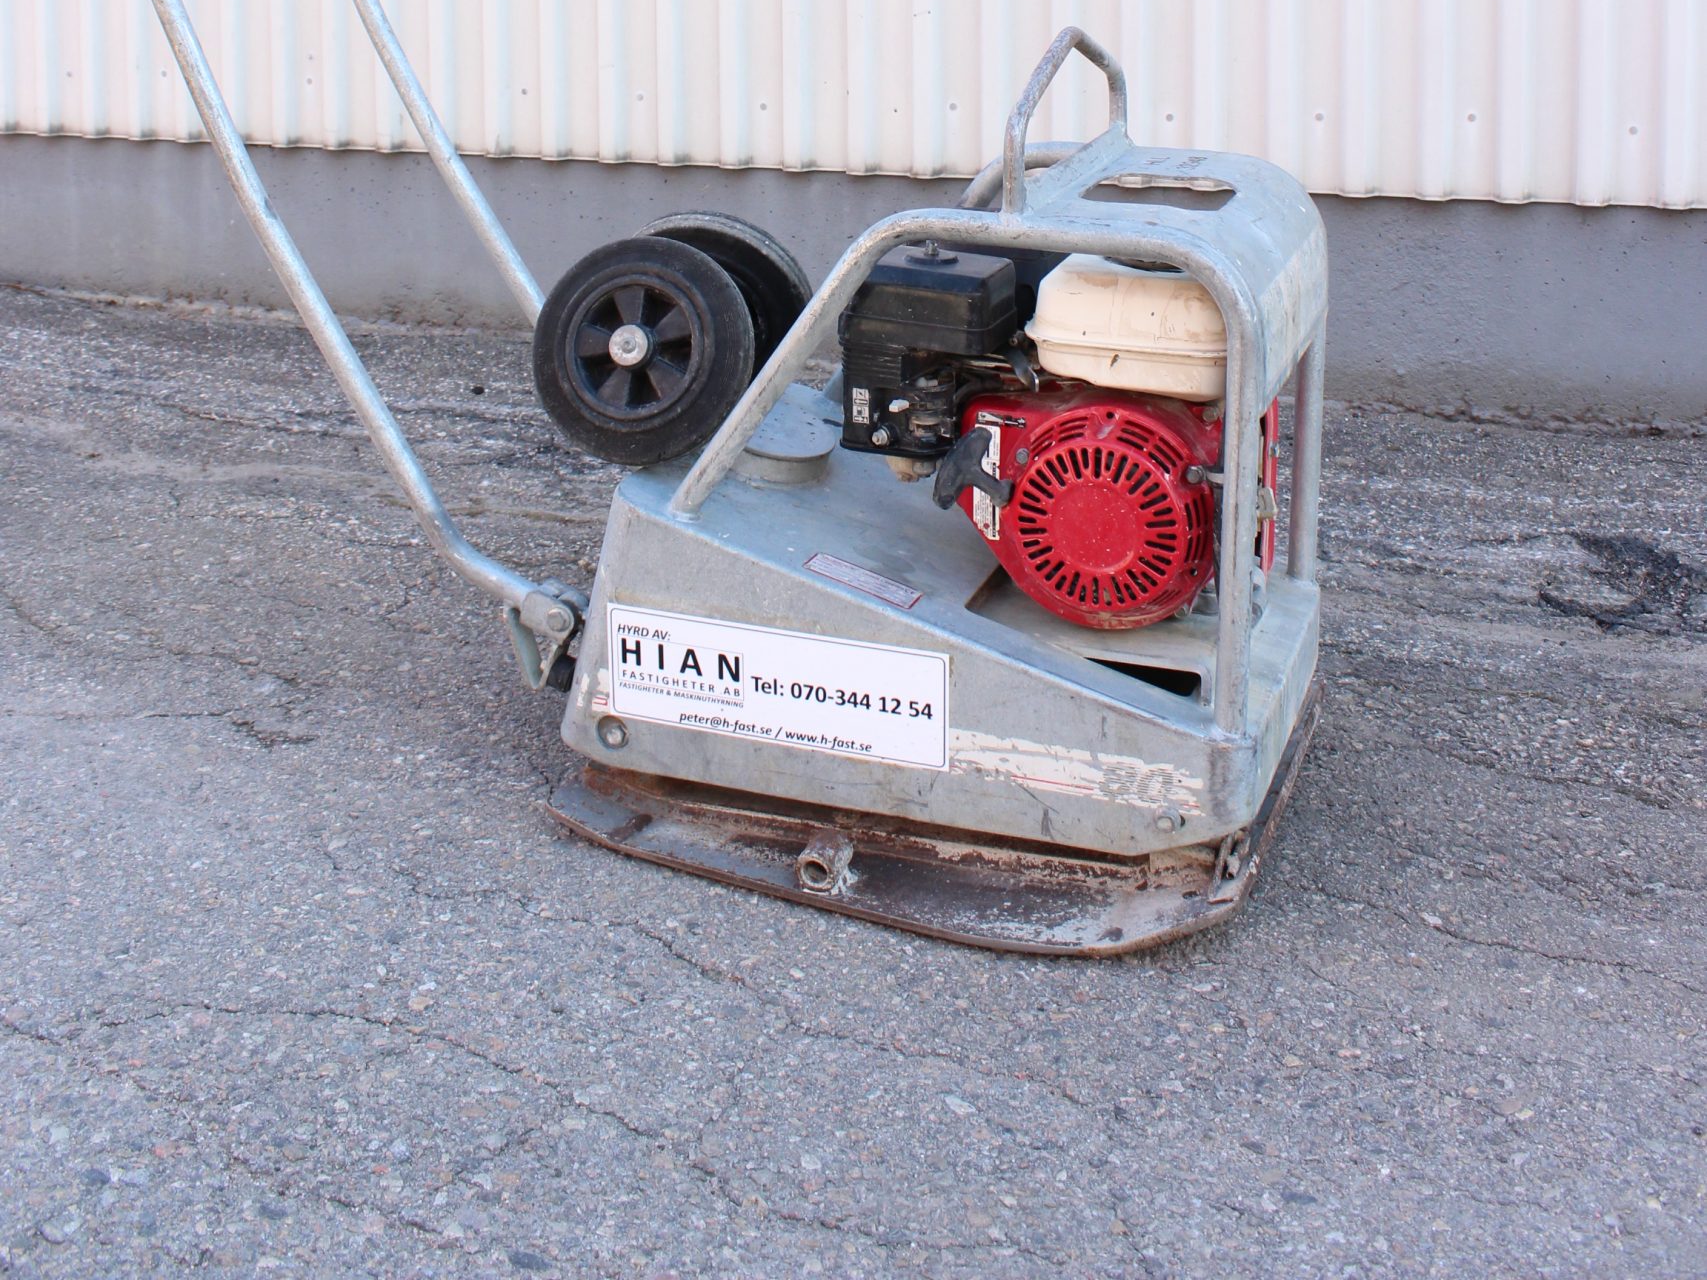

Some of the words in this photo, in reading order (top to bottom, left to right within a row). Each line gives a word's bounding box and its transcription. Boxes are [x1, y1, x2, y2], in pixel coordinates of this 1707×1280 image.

[617, 624, 649, 637] HYRD
[652, 629, 671, 641] AV:
[621, 637, 740, 683] HIAN
[619, 682, 664, 695] FASTIGHETER
[673, 690, 744, 708] MASKINUTHYRNING
[622, 669, 715, 693] FASTIGHETER
[723, 686, 741, 697] AB
[751, 676, 784, 697] Tel:
[790, 682, 872, 710] 070-344
[879, 696, 902, 715] 12
[909, 700, 934, 720] 54
[679, 712, 773, 737] peter@h-fast.se
[775, 727, 784, 740] /
[785, 730, 872, 753] www.h-fast.se
